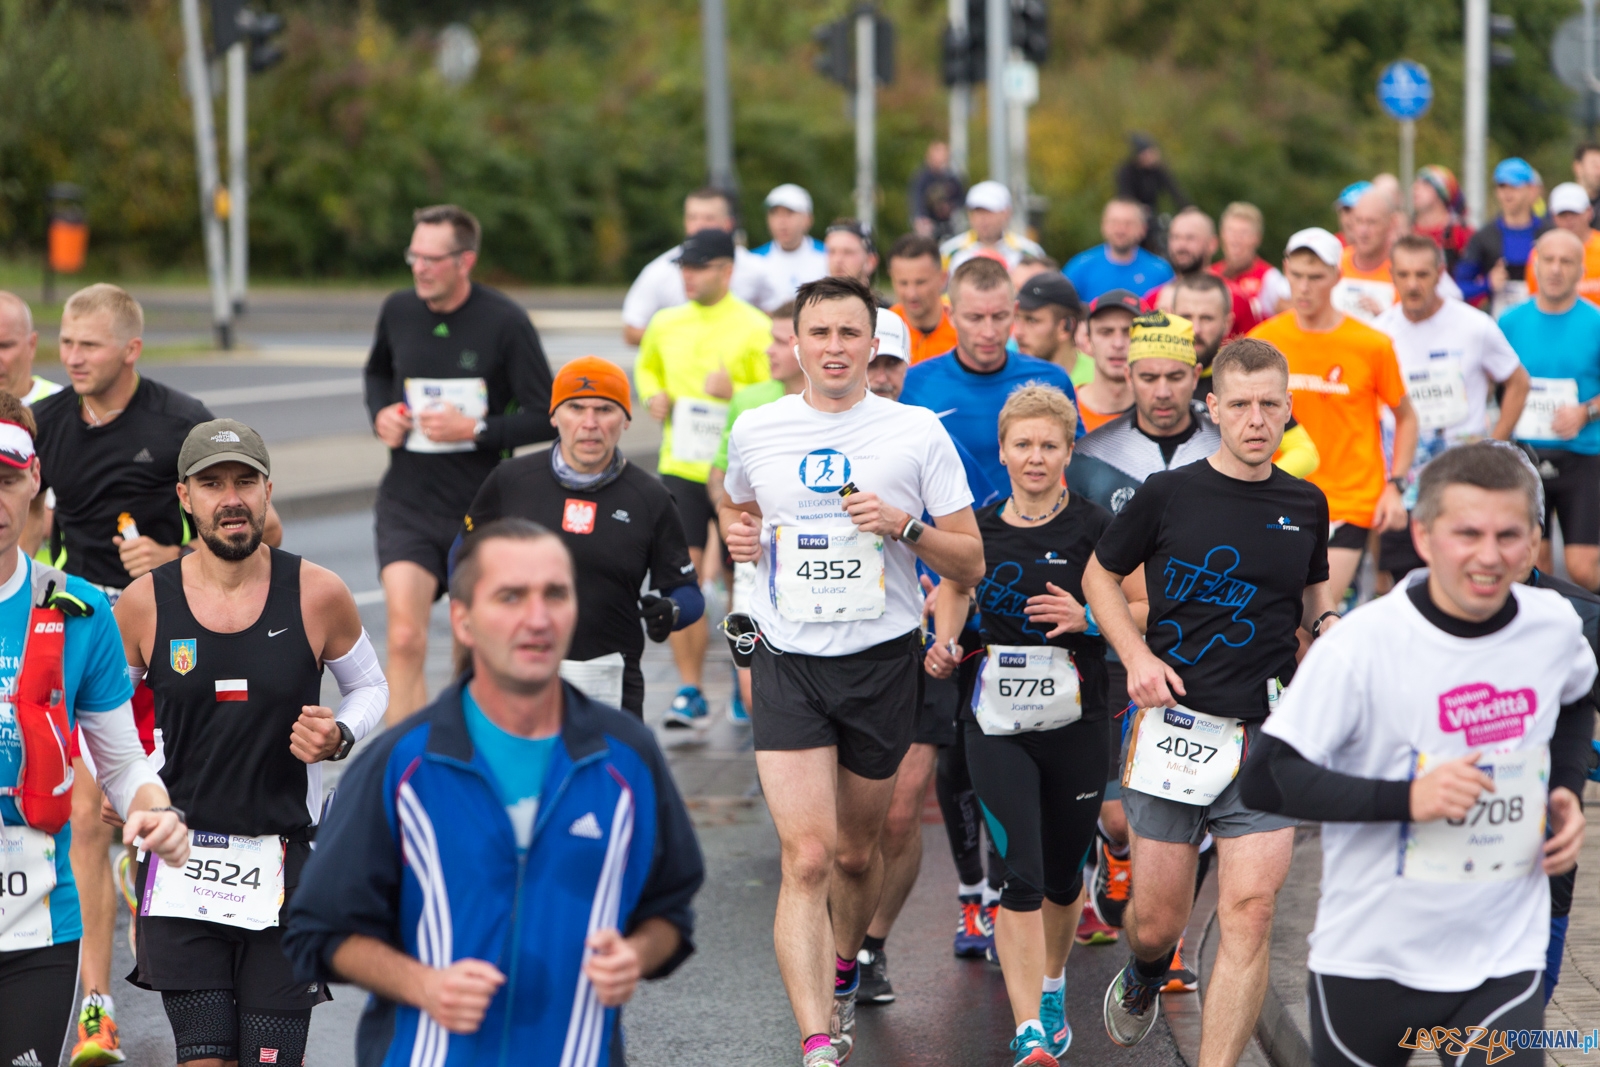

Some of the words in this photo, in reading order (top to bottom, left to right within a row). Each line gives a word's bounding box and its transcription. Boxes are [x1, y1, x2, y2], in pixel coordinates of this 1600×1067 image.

[798, 498, 843, 508] BIEGOSFE
[796, 559, 861, 580] 4352
[1163, 556, 1258, 607] TEAM
[811, 586, 847, 594] Łukasz
[999, 678, 1055, 697] 6778
[1011, 703, 1044, 711] Joanna
[1195, 725, 1221, 734] maraton
[1156, 736, 1218, 764] 4027
[1166, 761, 1198, 776] Michał
[231, 842, 261, 851] maraton
[1468, 834, 1504, 846] Adam
[184, 859, 261, 889] 3524
[193, 886, 246, 903] Krzysztof
